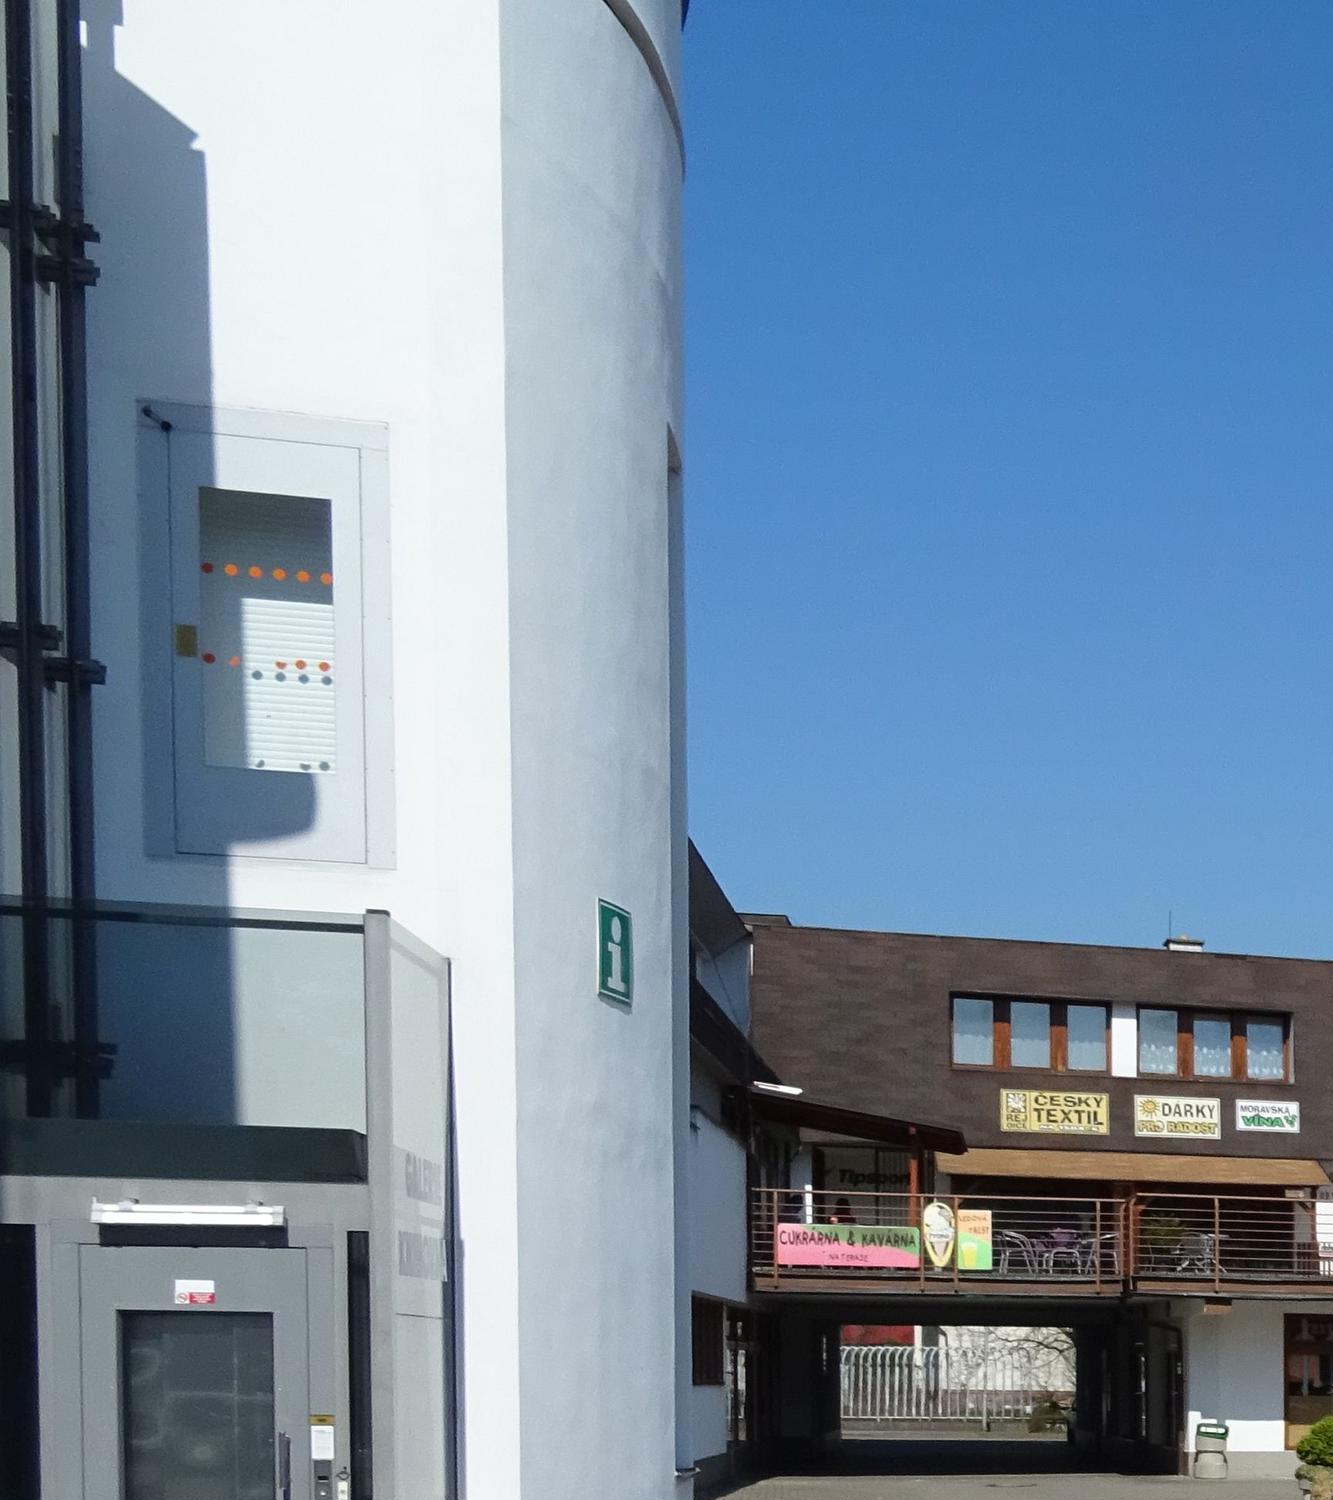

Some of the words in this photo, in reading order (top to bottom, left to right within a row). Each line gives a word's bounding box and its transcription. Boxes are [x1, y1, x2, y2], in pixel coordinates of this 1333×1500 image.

[1033, 1108, 1104, 1126] TEXTIL
[1138, 1119, 1164, 1133] PRO
[1167, 1121, 1218, 1135] RADOST
[847, 1233, 856, 1246] &
